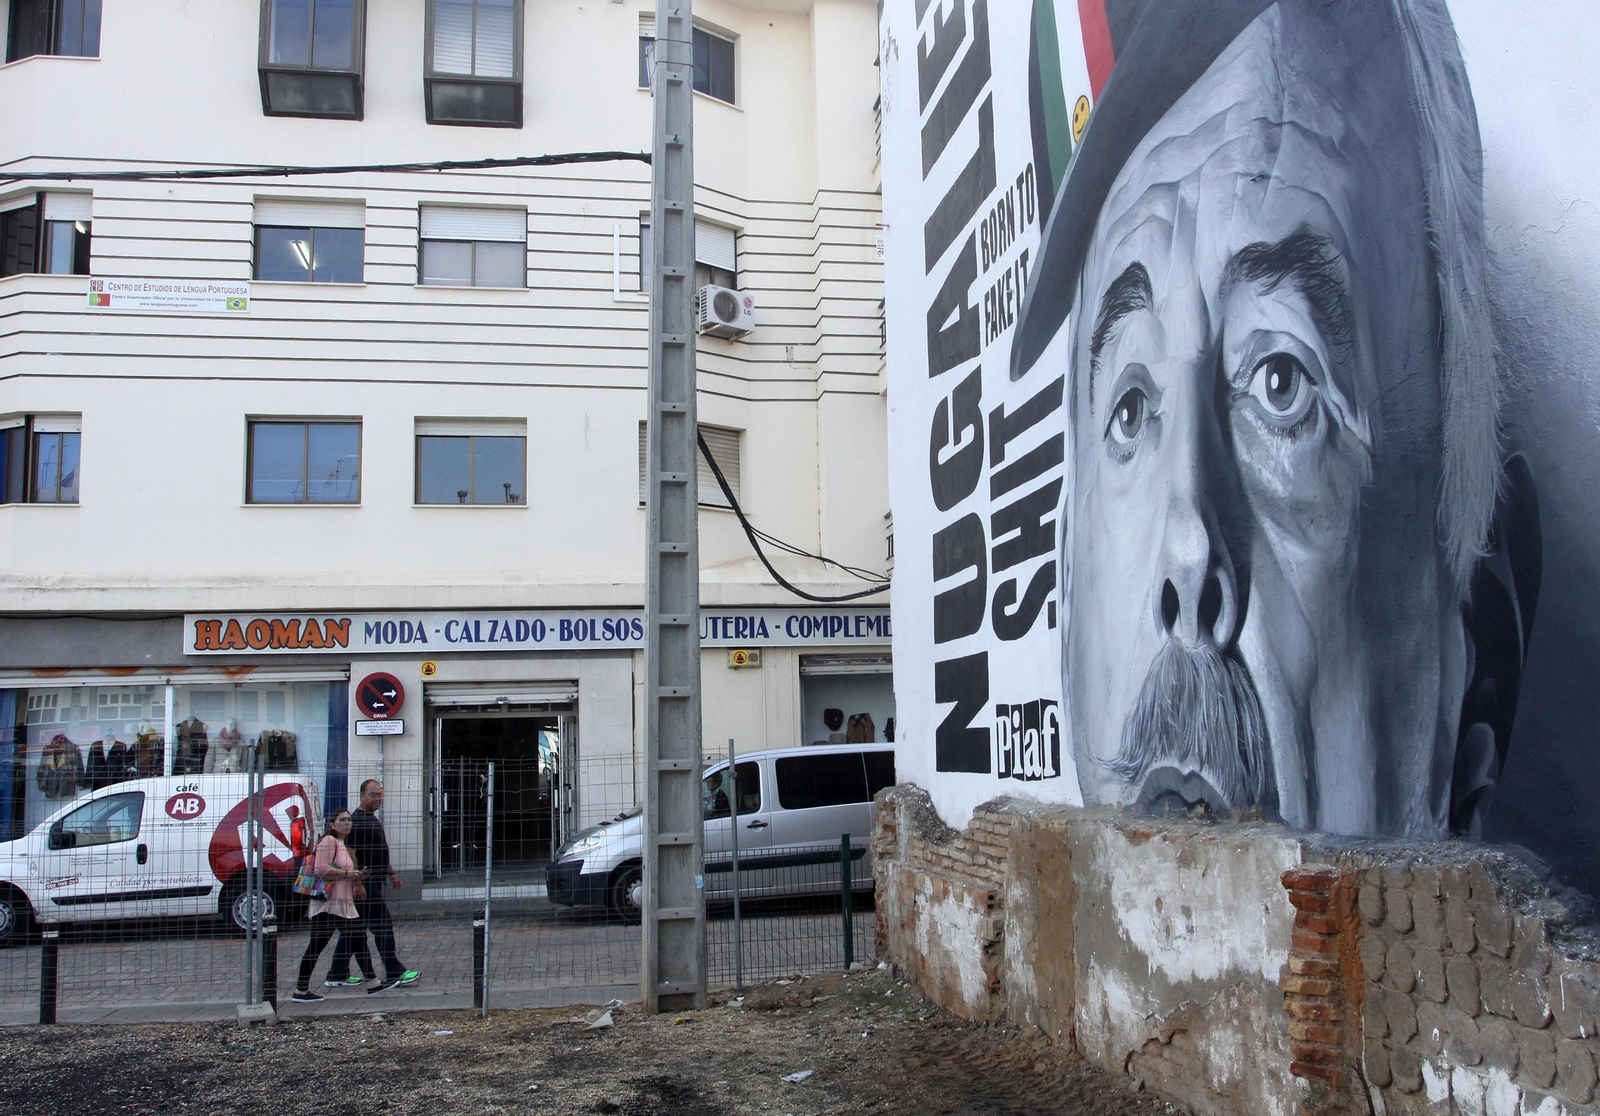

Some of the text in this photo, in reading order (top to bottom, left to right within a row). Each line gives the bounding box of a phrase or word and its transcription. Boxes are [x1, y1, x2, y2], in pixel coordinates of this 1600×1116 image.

[980, 161, 1035, 275] BORN TO
[108, 282, 247, 295] CENTRO DE ESTUDIOS DE LENGUA PORTUGUESA
[984, 247, 1030, 348] FAKE IT
[989, 374, 1065, 642] SHIT
[194, 618, 351, 650] HAOMAN
[364, 619, 428, 645] MODA
[444, 618, 546, 644] CALZADO
[559, 617, 644, 642] BOLSOS
[700, 616, 770, 640] TERIA
[785, 615, 892, 639] COMPLEME
[996, 698, 1061, 781] Piaf
[175, 782, 199, 792] café
[170, 798, 200, 815] AB
[110, 873, 203, 888] Calidad por naturaleza
